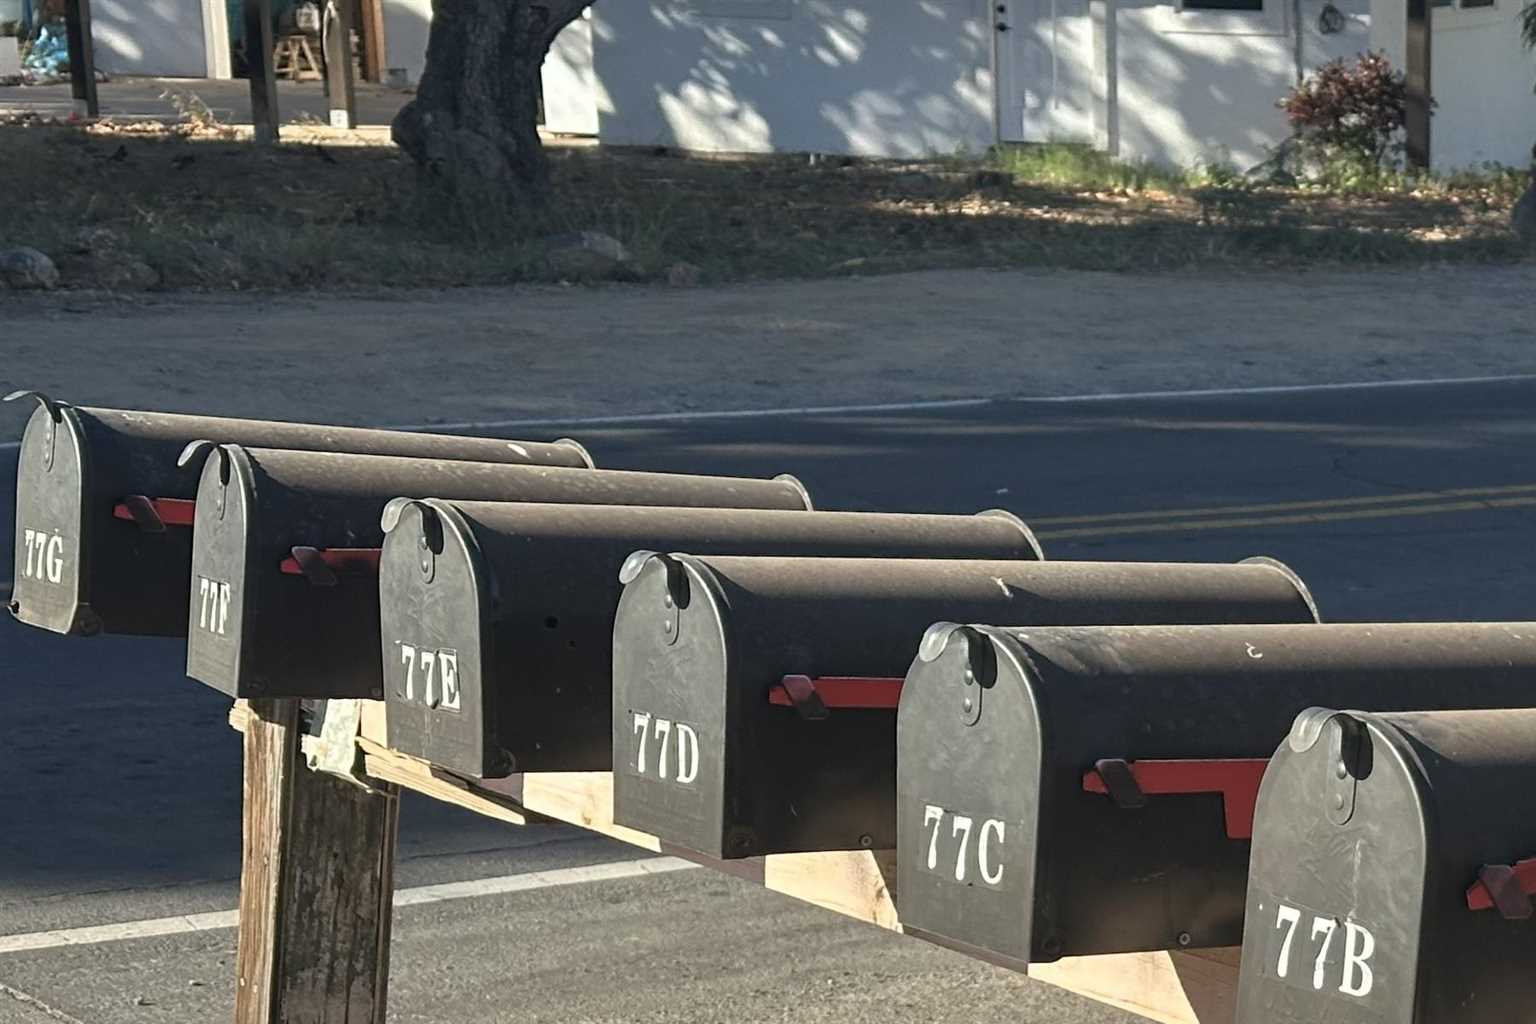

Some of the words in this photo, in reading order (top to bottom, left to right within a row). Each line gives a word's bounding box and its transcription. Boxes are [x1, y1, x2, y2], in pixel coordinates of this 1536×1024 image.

[24, 529, 64, 584] 77G
[199, 578, 231, 635] 77F
[401, 644, 461, 711] 77E
[633, 711, 700, 784] 77D
[923, 804, 1006, 885] 77C
[1276, 904, 1376, 997] 77B
